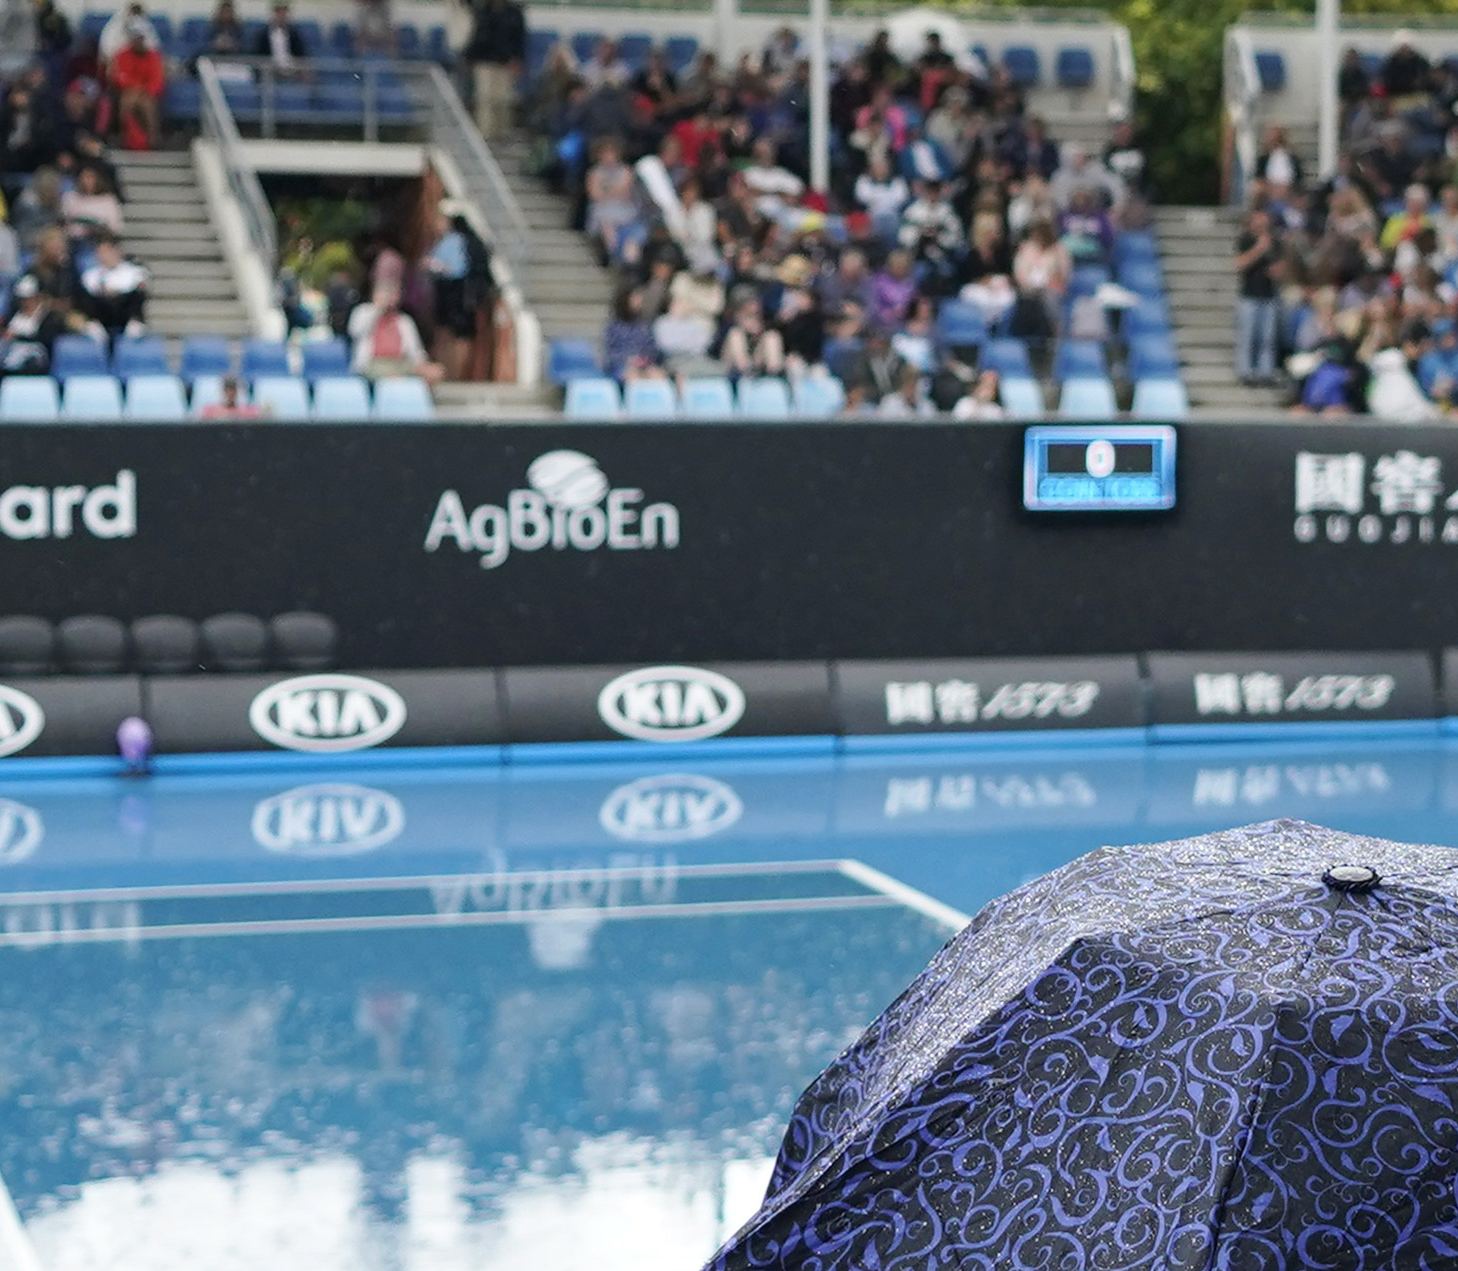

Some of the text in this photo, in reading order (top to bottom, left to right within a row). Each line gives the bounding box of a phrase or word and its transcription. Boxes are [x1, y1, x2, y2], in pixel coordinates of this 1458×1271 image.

[1086, 439, 1115, 478] 0
[425, 488, 680, 569] AgBioEn
[274, 690, 384, 738] KIA
[620, 683, 721, 729] KIA
